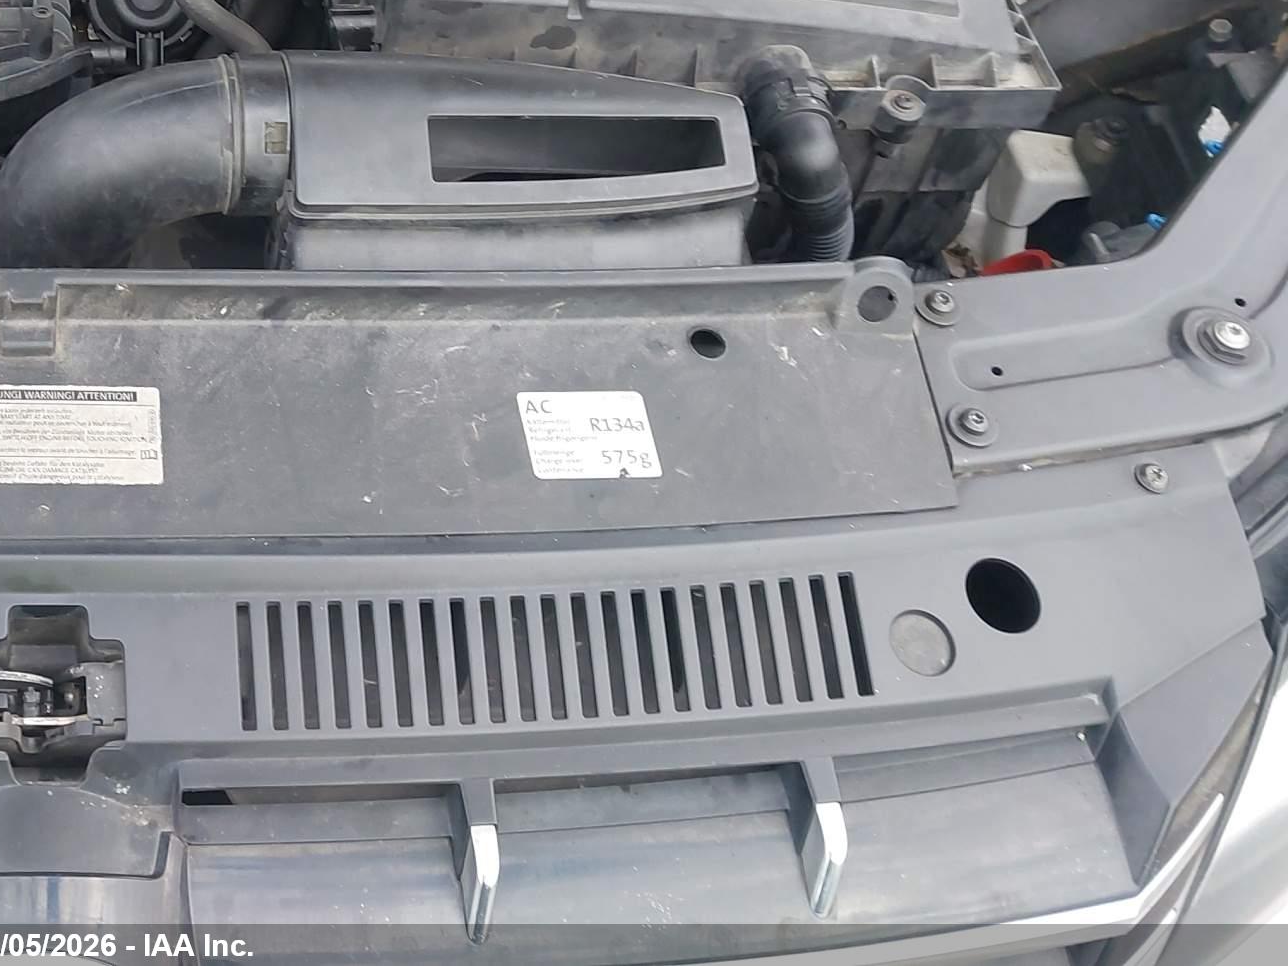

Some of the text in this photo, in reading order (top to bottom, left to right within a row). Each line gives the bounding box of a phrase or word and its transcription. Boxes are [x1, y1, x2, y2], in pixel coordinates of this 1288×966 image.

[23, 390, 75, 400] WARNING!
[76, 391, 134, 401] ATTENTION!
[525, 399, 553, 414] AC
[589, 417, 645, 432] R134a
[601, 449, 652, 469] 575g
